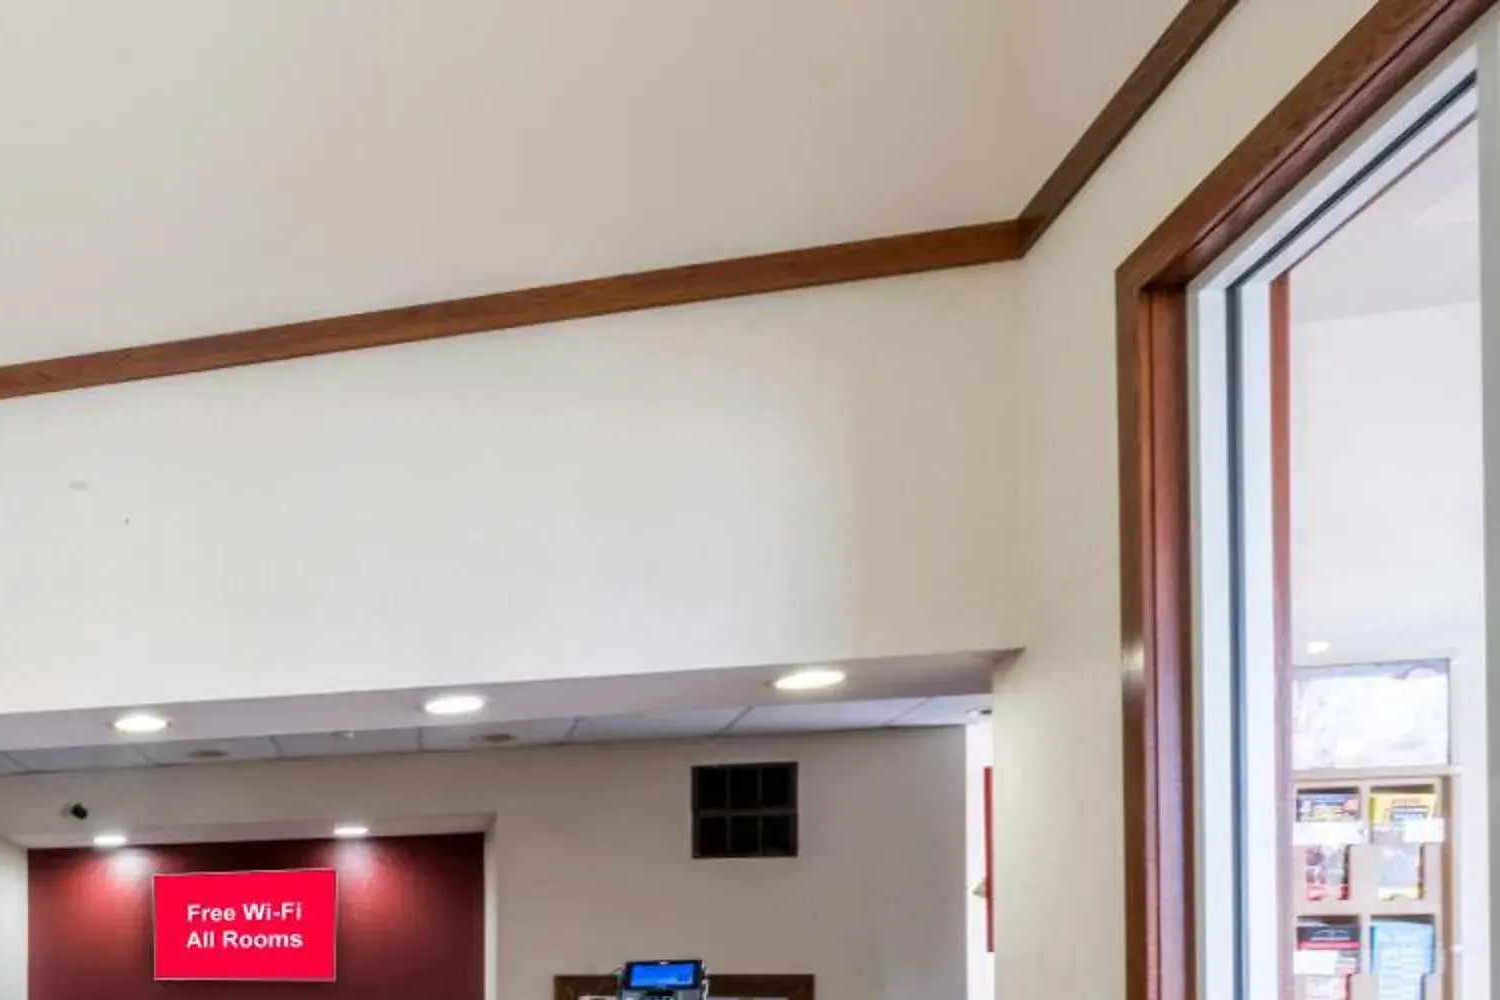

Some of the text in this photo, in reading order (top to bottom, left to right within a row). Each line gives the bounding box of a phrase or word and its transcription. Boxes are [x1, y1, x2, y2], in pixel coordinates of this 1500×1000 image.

[187, 901, 302, 922] Free Wi-Fi
[186, 930, 303, 949] All Rooms
